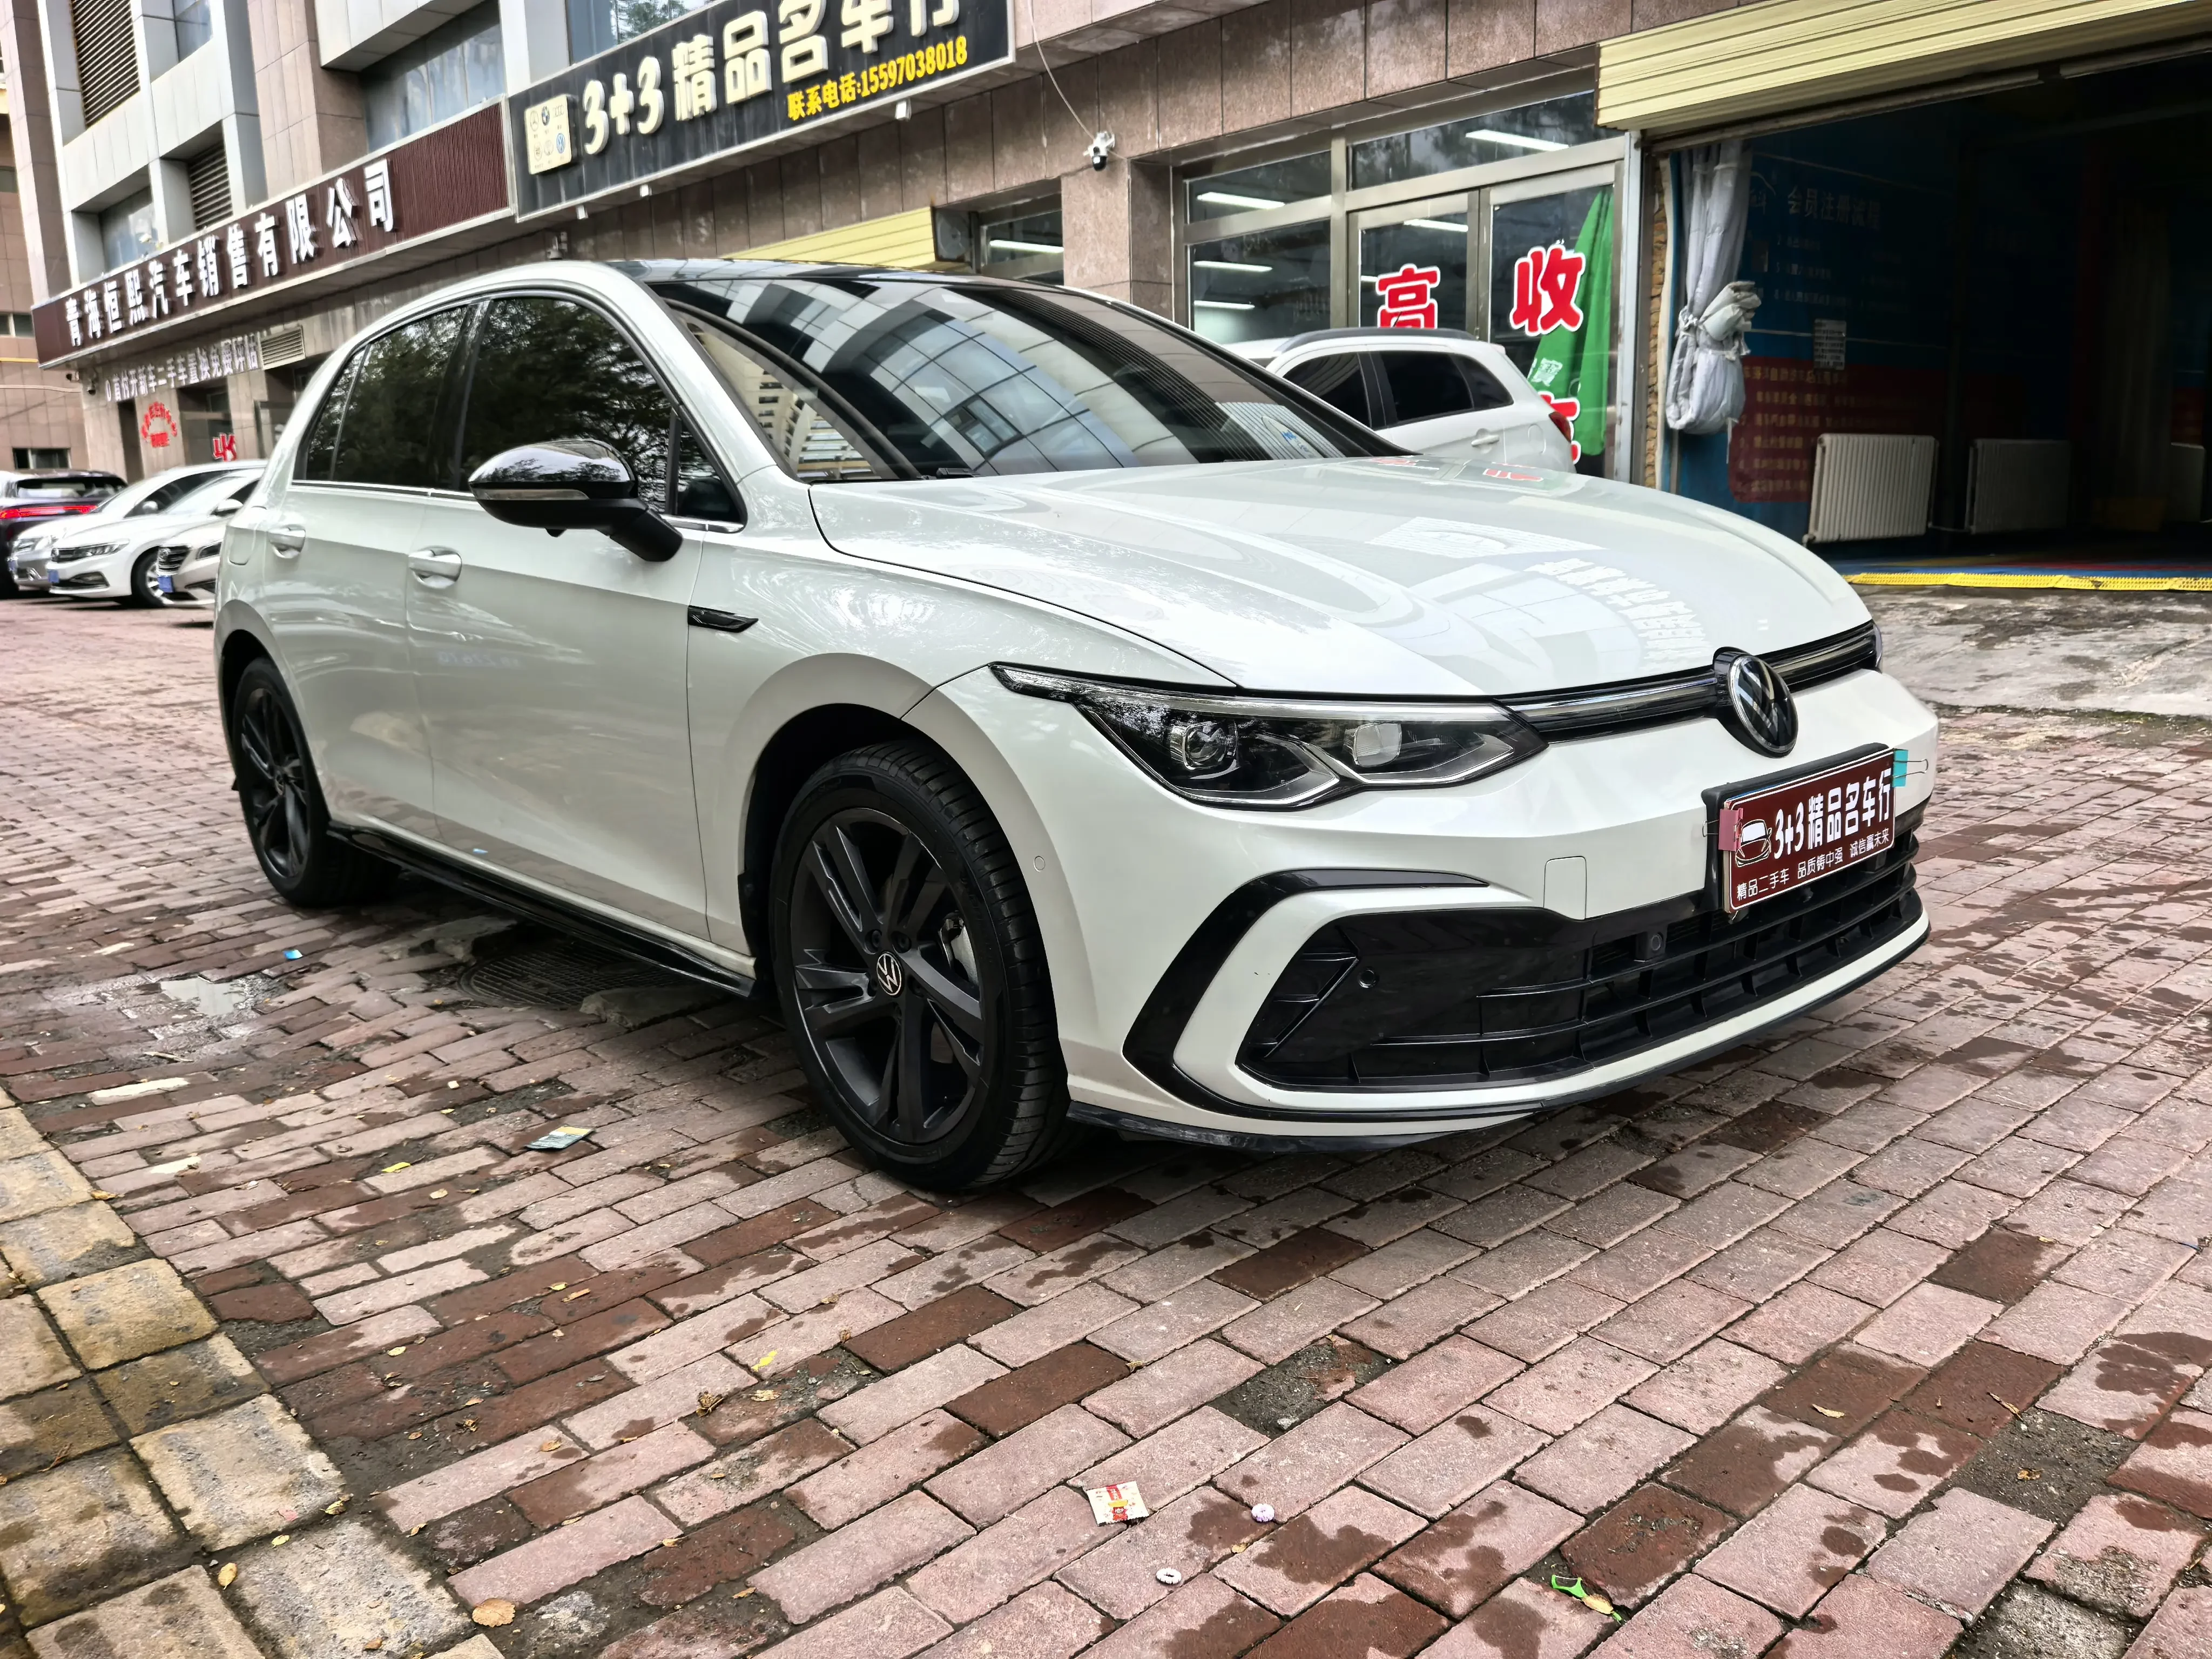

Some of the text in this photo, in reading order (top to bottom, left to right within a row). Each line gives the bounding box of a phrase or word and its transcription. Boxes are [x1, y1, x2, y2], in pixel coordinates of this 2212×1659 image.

[787, 36, 968, 121] 联系电话:15597038018
[65, 159, 395, 347] 青海恒熙汽车销售有限公司
[1375, 264, 1441, 329] 高
[1510, 246, 1586, 336] 收
[1773, 768, 1891, 859] 3+3精品名车行
[1737, 827, 1889, 900] 精品二手车 品质铸中强 诚信赢未来
